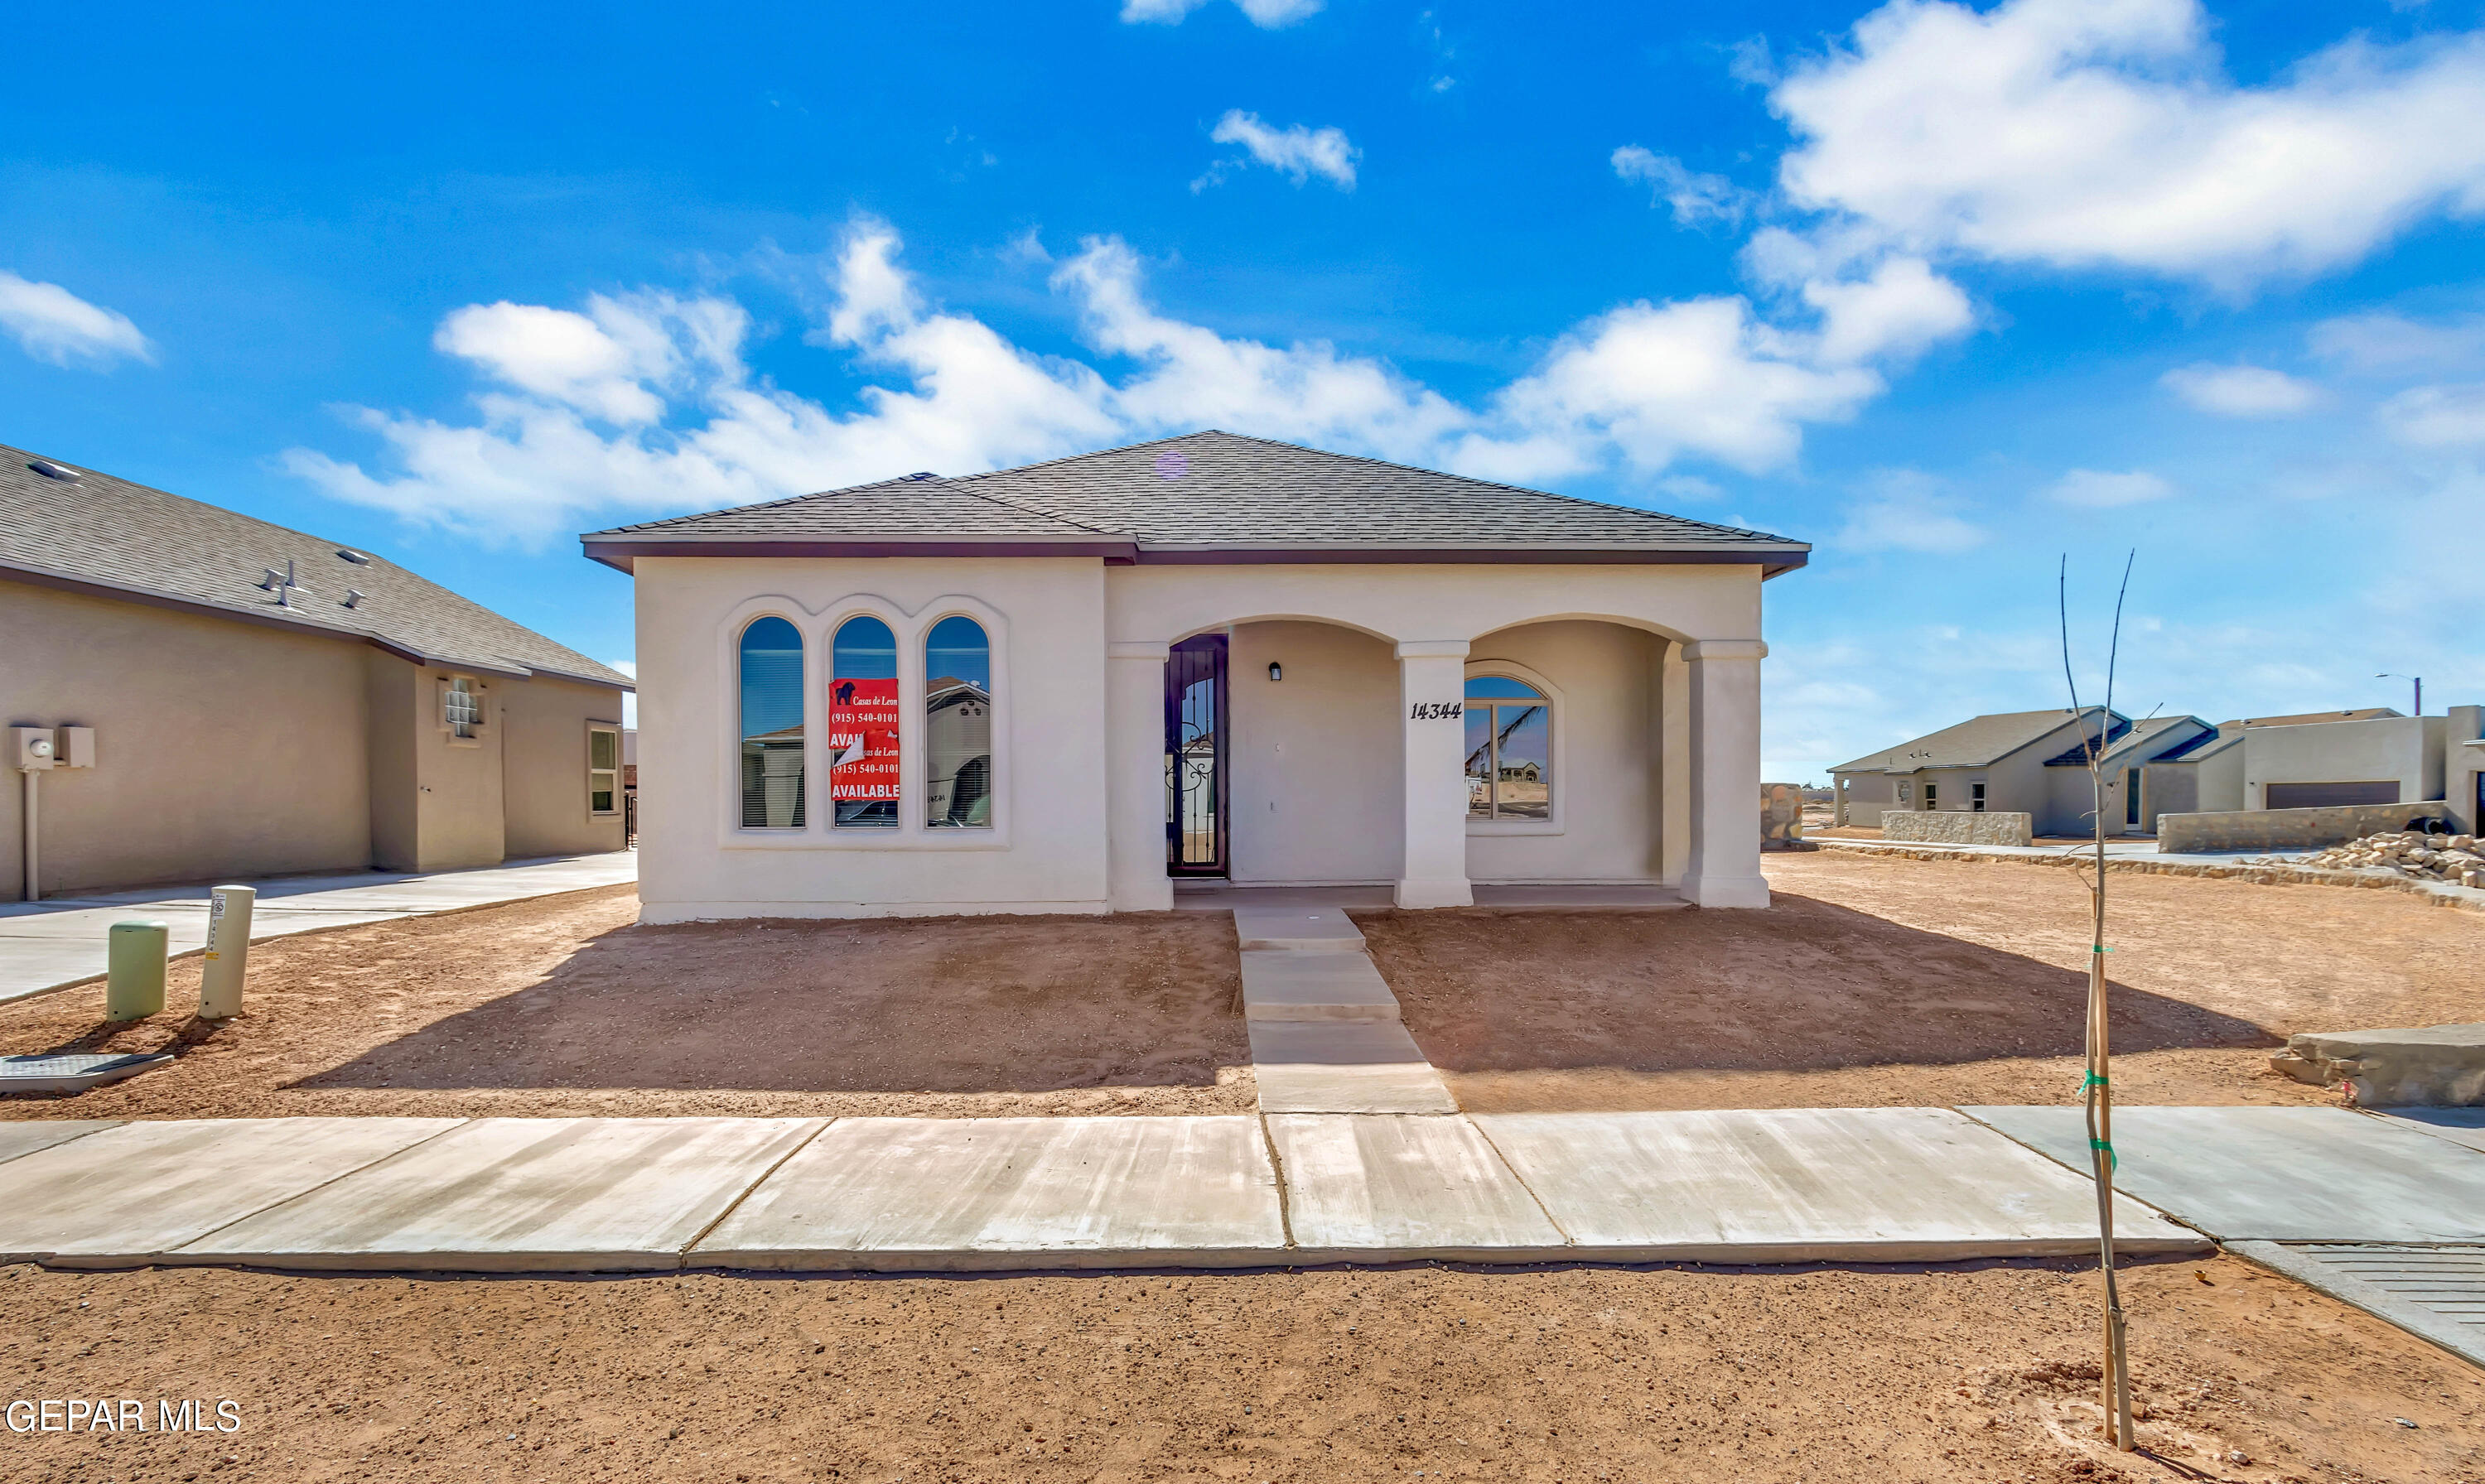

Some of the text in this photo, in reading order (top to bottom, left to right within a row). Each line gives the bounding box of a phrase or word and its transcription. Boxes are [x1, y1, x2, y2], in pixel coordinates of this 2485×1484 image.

[853, 696, 898, 706] Casas de Leon
[1411, 702, 1462, 720] 14344
[832, 713, 897, 724] (915) 540-0101
[874, 747, 882, 756] de
[883, 747, 899, 756] Leon
[833, 764, 899, 775] (915) 540-0101
[832, 784, 900, 797] AVAILABLE
